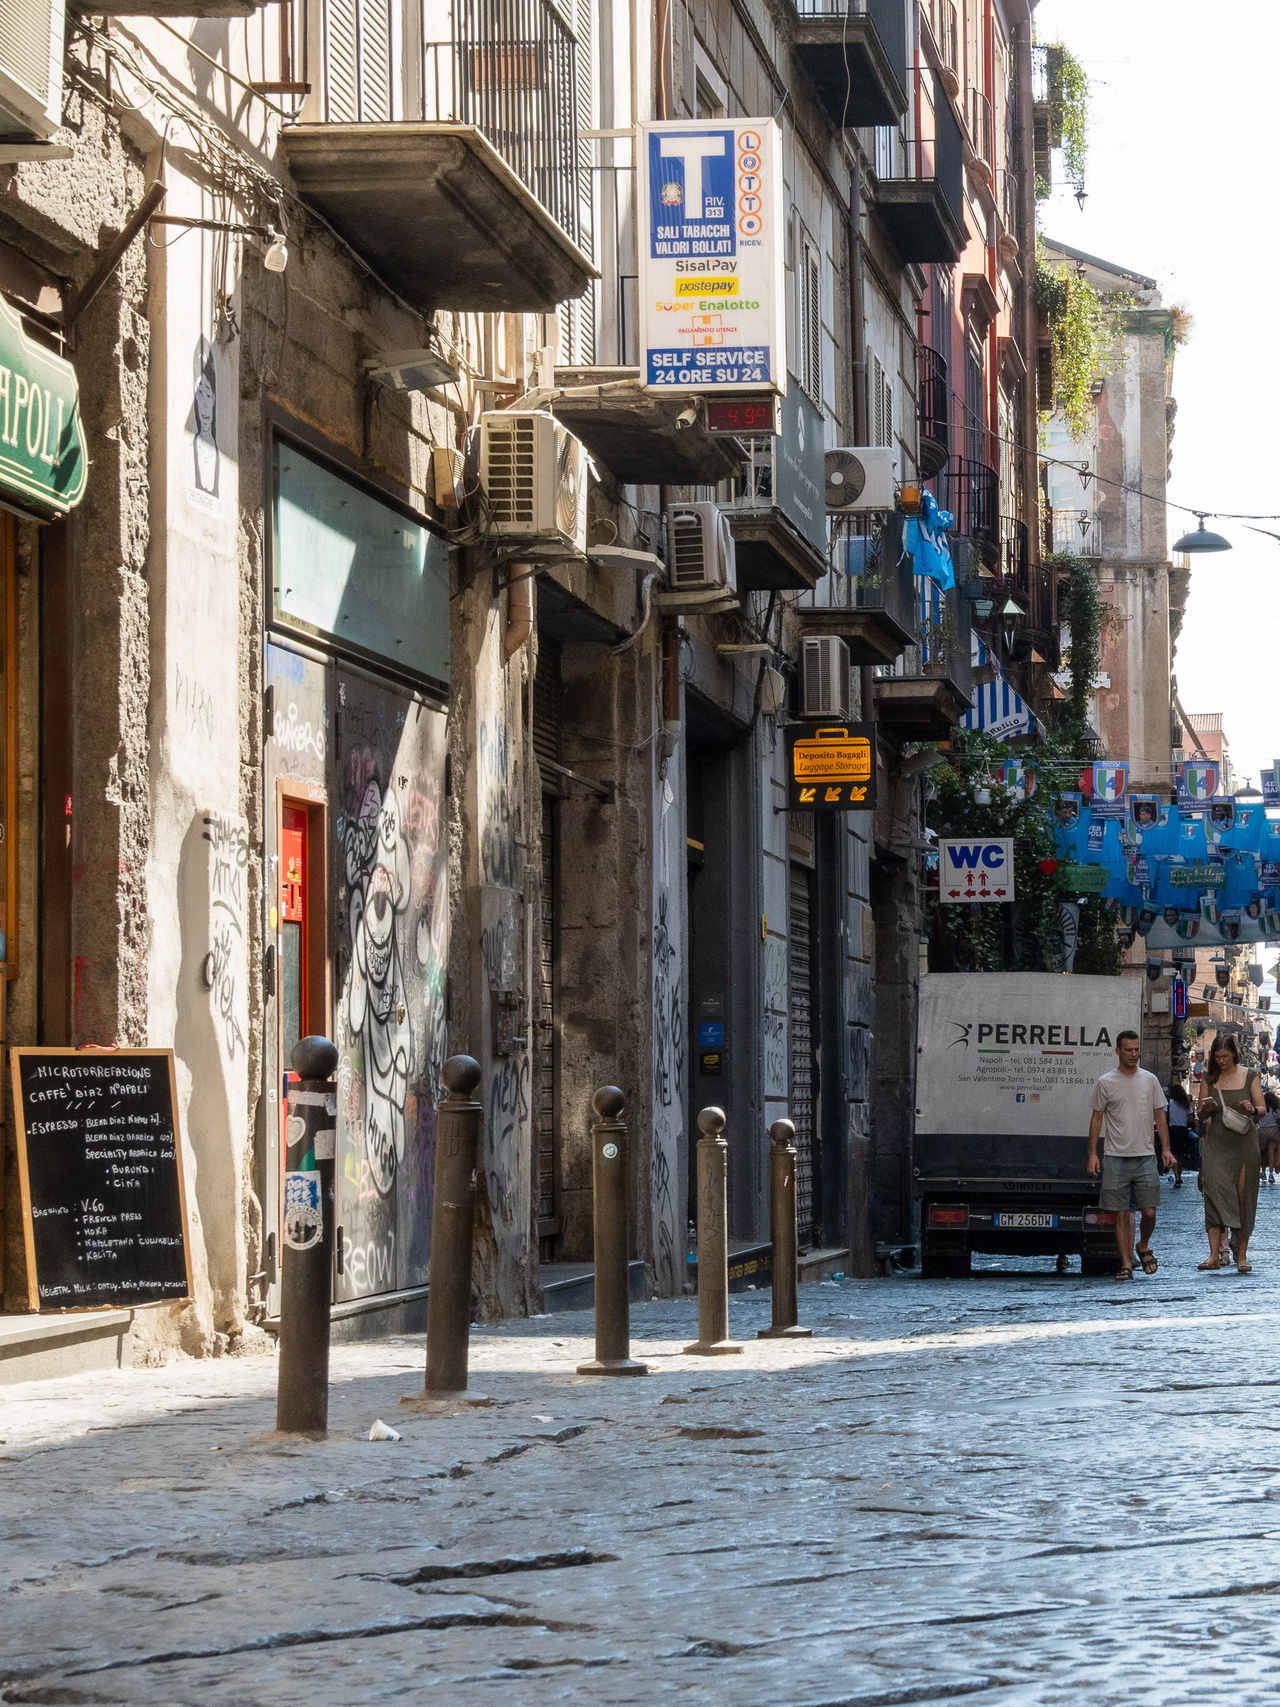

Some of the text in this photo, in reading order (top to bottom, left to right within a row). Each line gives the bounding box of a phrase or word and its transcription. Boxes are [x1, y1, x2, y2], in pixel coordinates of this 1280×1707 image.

[660, 136, 726, 219] T
[738, 130, 762, 236] LOTTO
[705, 196, 725, 207] RIV.
[707, 208, 723, 217] 313
[657, 224, 730, 240] SALI TABACCHI
[655, 239, 732, 255] VALORI BOLLATI
[675, 259, 738, 273] SisalPay
[678, 281, 735, 293] postepay
[655, 300, 760, 313] Super Enalotto
[652, 351, 765, 367] SELF SERVICE
[655, 367, 762, 383] 24 ORE SU 24
[799, 750, 866, 760] Deposito Bagagli
[800, 762, 866, 772] Luggage Storage
[947, 845, 1005, 869] WC
[978, 1024, 1112, 1047] PERRELLA
[980, 1057, 1003, 1065] Napoli
[976, 1066, 1006, 1074] Agropoli
[1000, 1084, 1052, 1092] www.perrellasrl.it
[368, 1103, 393, 1177] HUGO
[82, 1213, 142, 1224] FRENCH PRESS
[1001, 1214, 1051, 1226] GM 256DW
